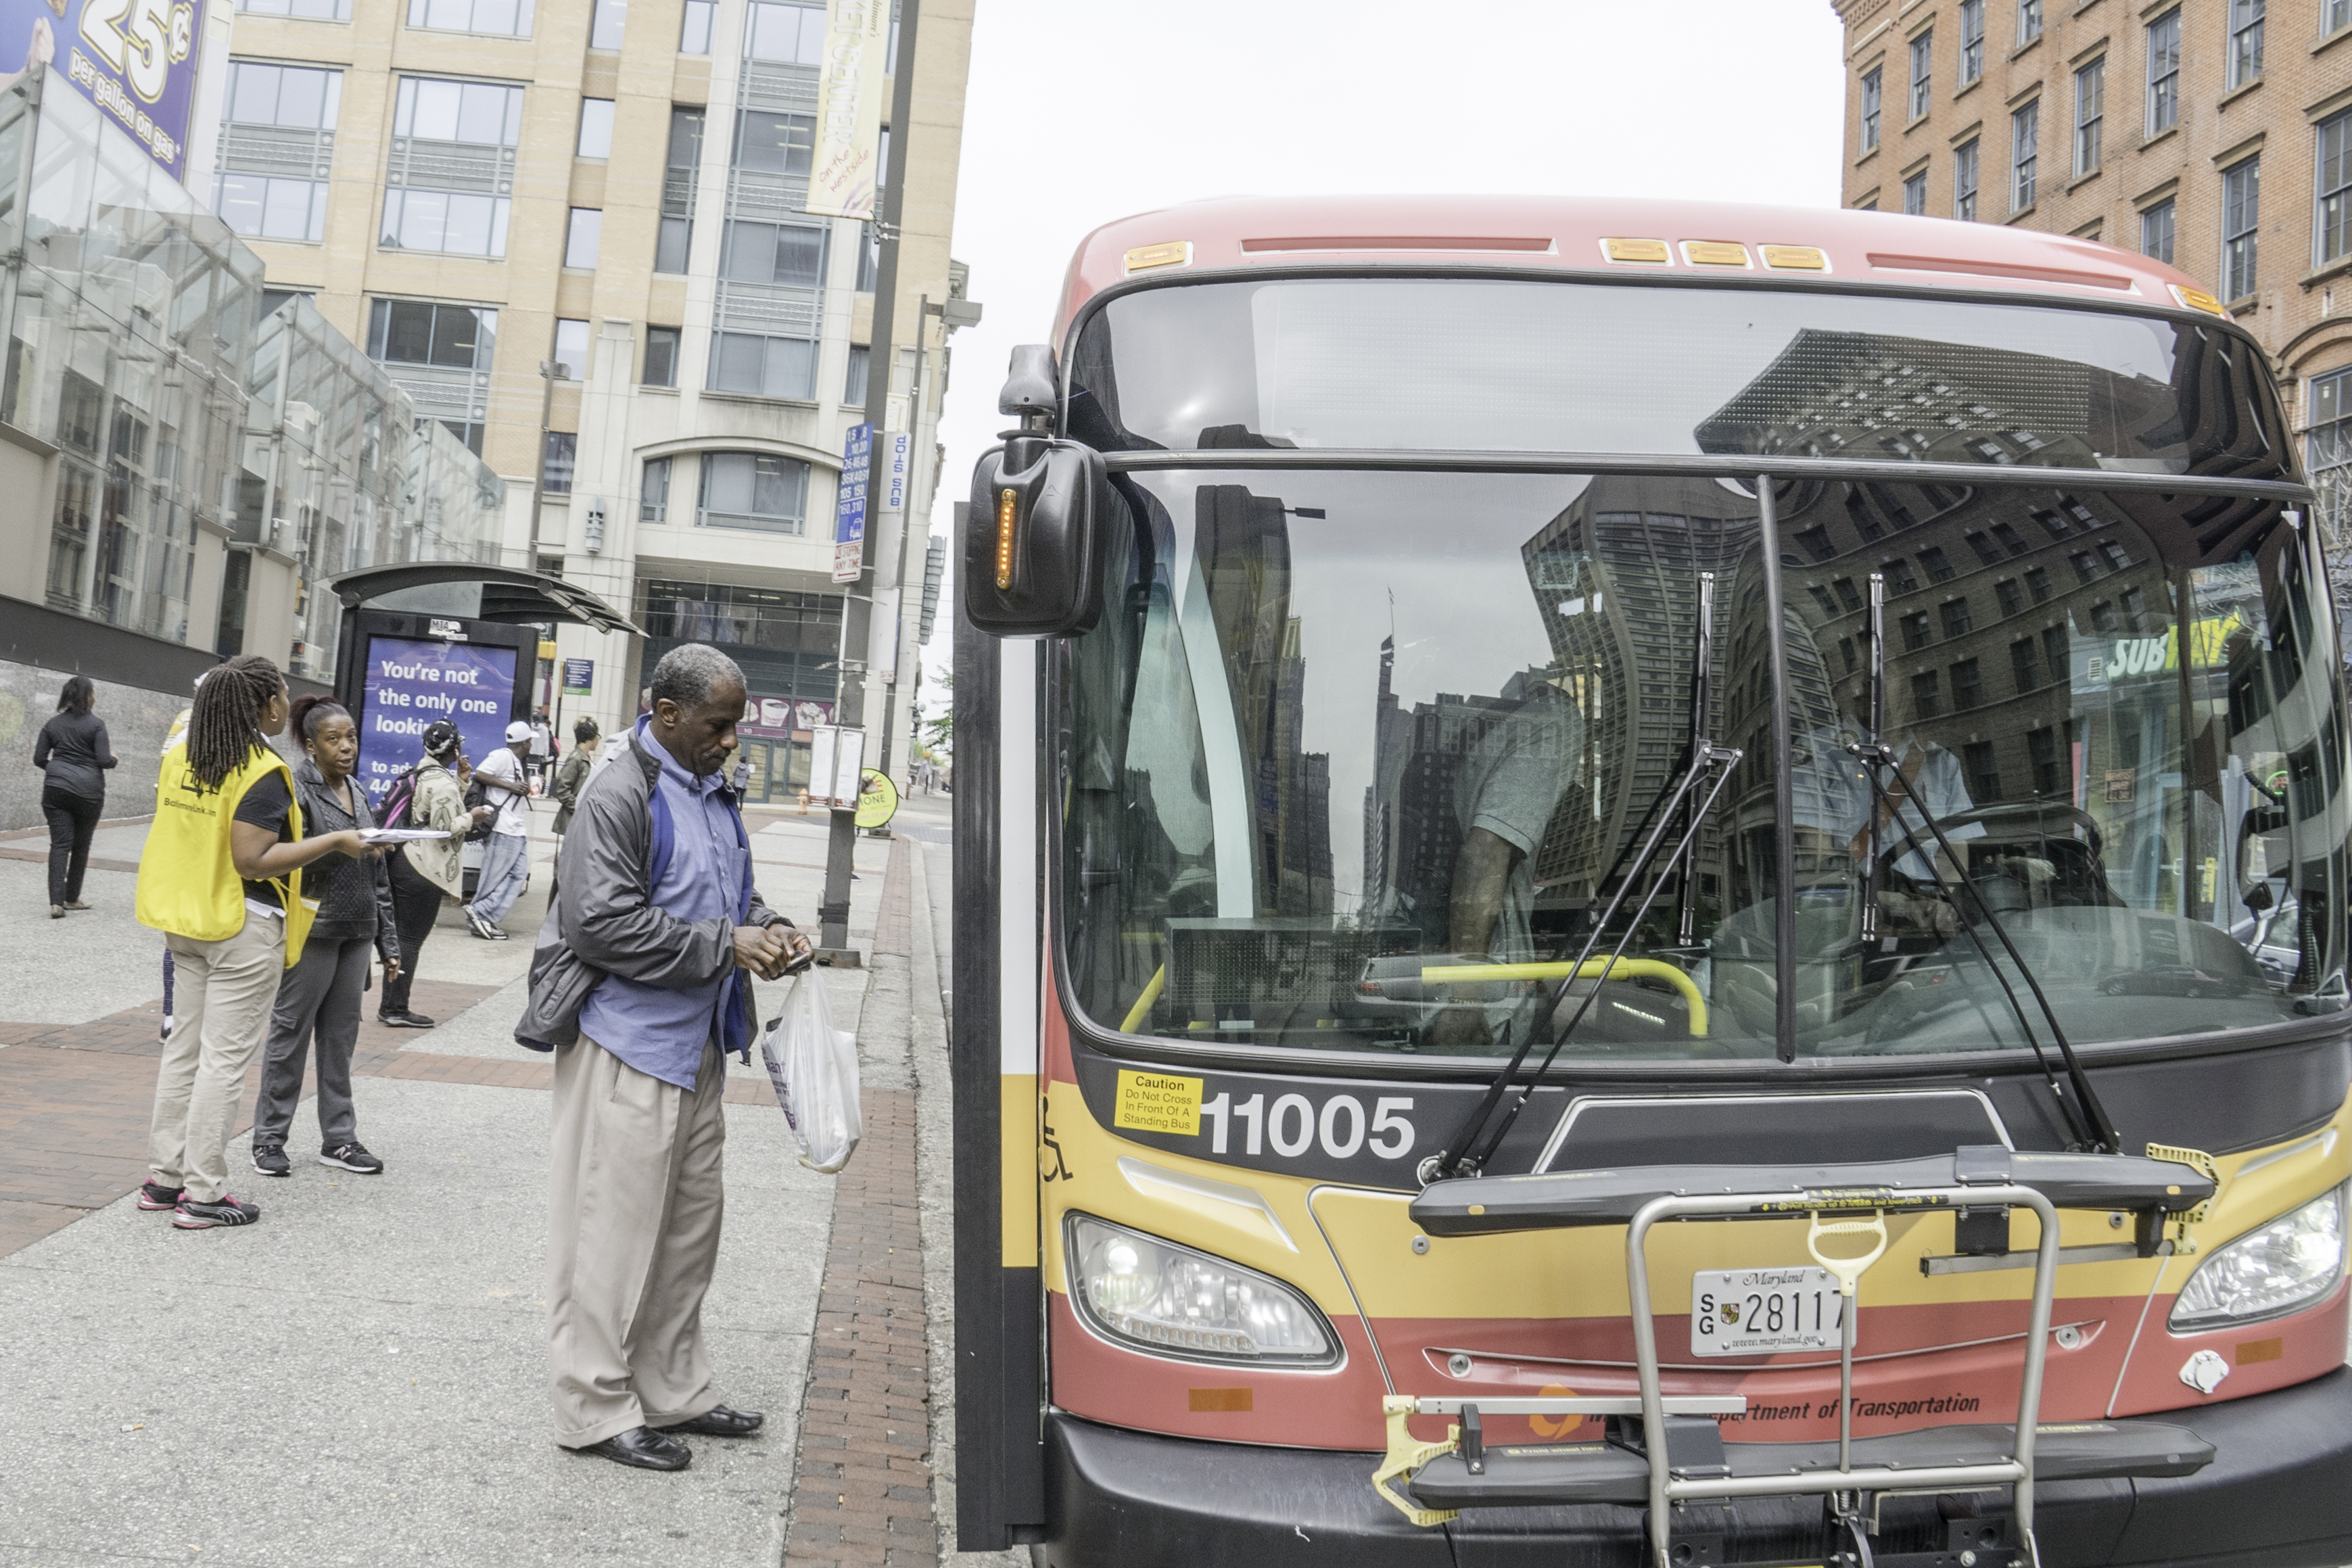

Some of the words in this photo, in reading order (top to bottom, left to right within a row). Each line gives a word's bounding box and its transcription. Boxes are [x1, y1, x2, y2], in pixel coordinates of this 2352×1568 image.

[69, 45, 96, 89] per
[95, 72, 135, 128] gallon
[135, 110, 154, 145] on
[823, 44, 862, 144] CENTER
[819, 167, 833, 183] on
[832, 149, 851, 168] the
[893, 435, 906, 473] STOP
[890, 477, 902, 506] BUS
[381, 661, 440, 682] You're
[445, 669, 479, 685] not
[379, 688, 410, 707] the
[415, 692, 457, 714] only
[461, 699, 498, 714] one
[371, 761, 387, 774] to
[1136, 1076, 1184, 1091] Caution
[1125, 1101, 1134, 1110] In
[1137, 1102, 1163, 1114] Front
[1167, 1106, 1179, 1116] Of
[1182, 1108, 1190, 1117] A
[1126, 1089, 1139, 1099] Do
[1142, 1091, 1159, 1101] Not
[1162, 1093, 1192, 1105] Cross
[1124, 1113, 1168, 1129] Standing
[1171, 1118, 1190, 1129] Bus
[1200, 1093, 1415, 1159] 11005
[1743, 1270, 1806, 1289] Maryland
[1745, 1290, 1843, 1333] 28117
[1732, 1333, 1818, 1348] www.maryland.gov
[1818, 1399, 1839, 1419] of
[1849, 1394, 1979, 1419] Transportation
